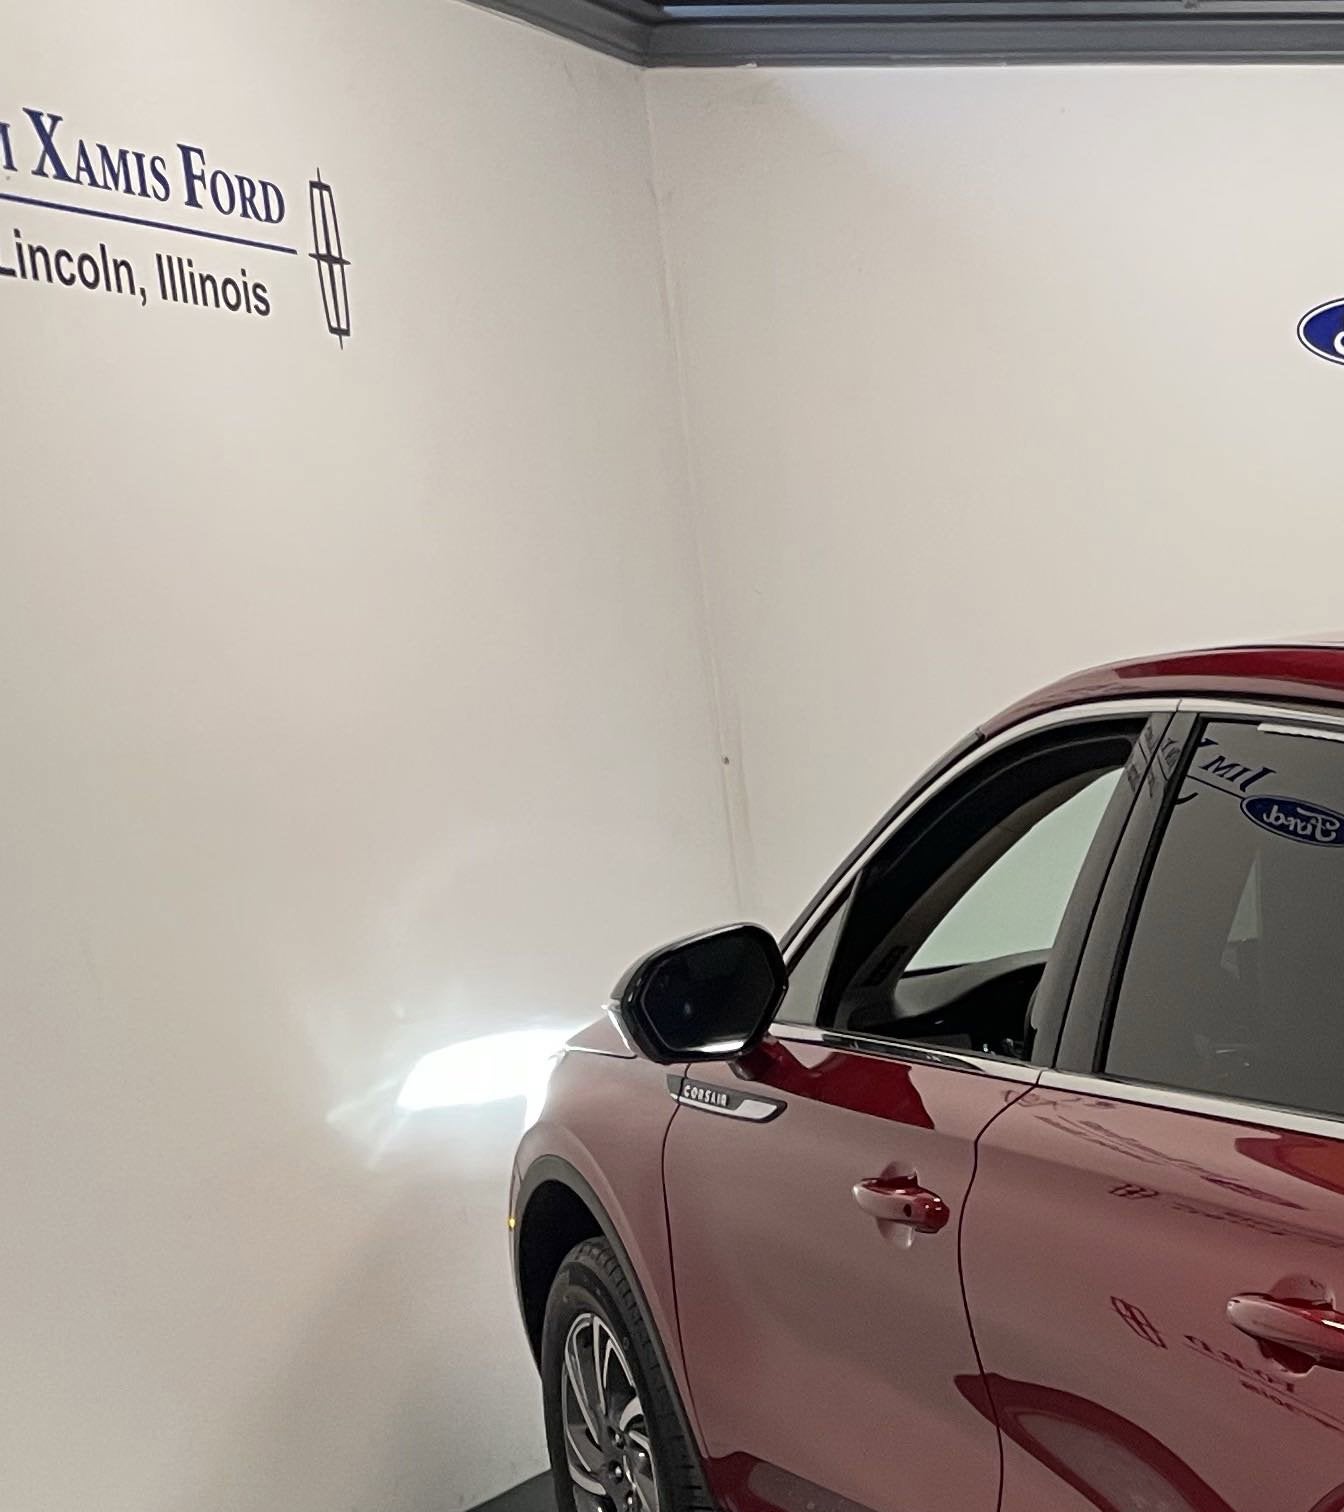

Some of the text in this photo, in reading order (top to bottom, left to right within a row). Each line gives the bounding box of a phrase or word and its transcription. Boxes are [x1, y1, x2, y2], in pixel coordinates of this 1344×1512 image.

[22, 107, 171, 202] XAMIS
[177, 144, 285, 224] FORD
[156, 253, 271, 317] Illinois
[683, 1085, 729, 1106] CORSAIR
